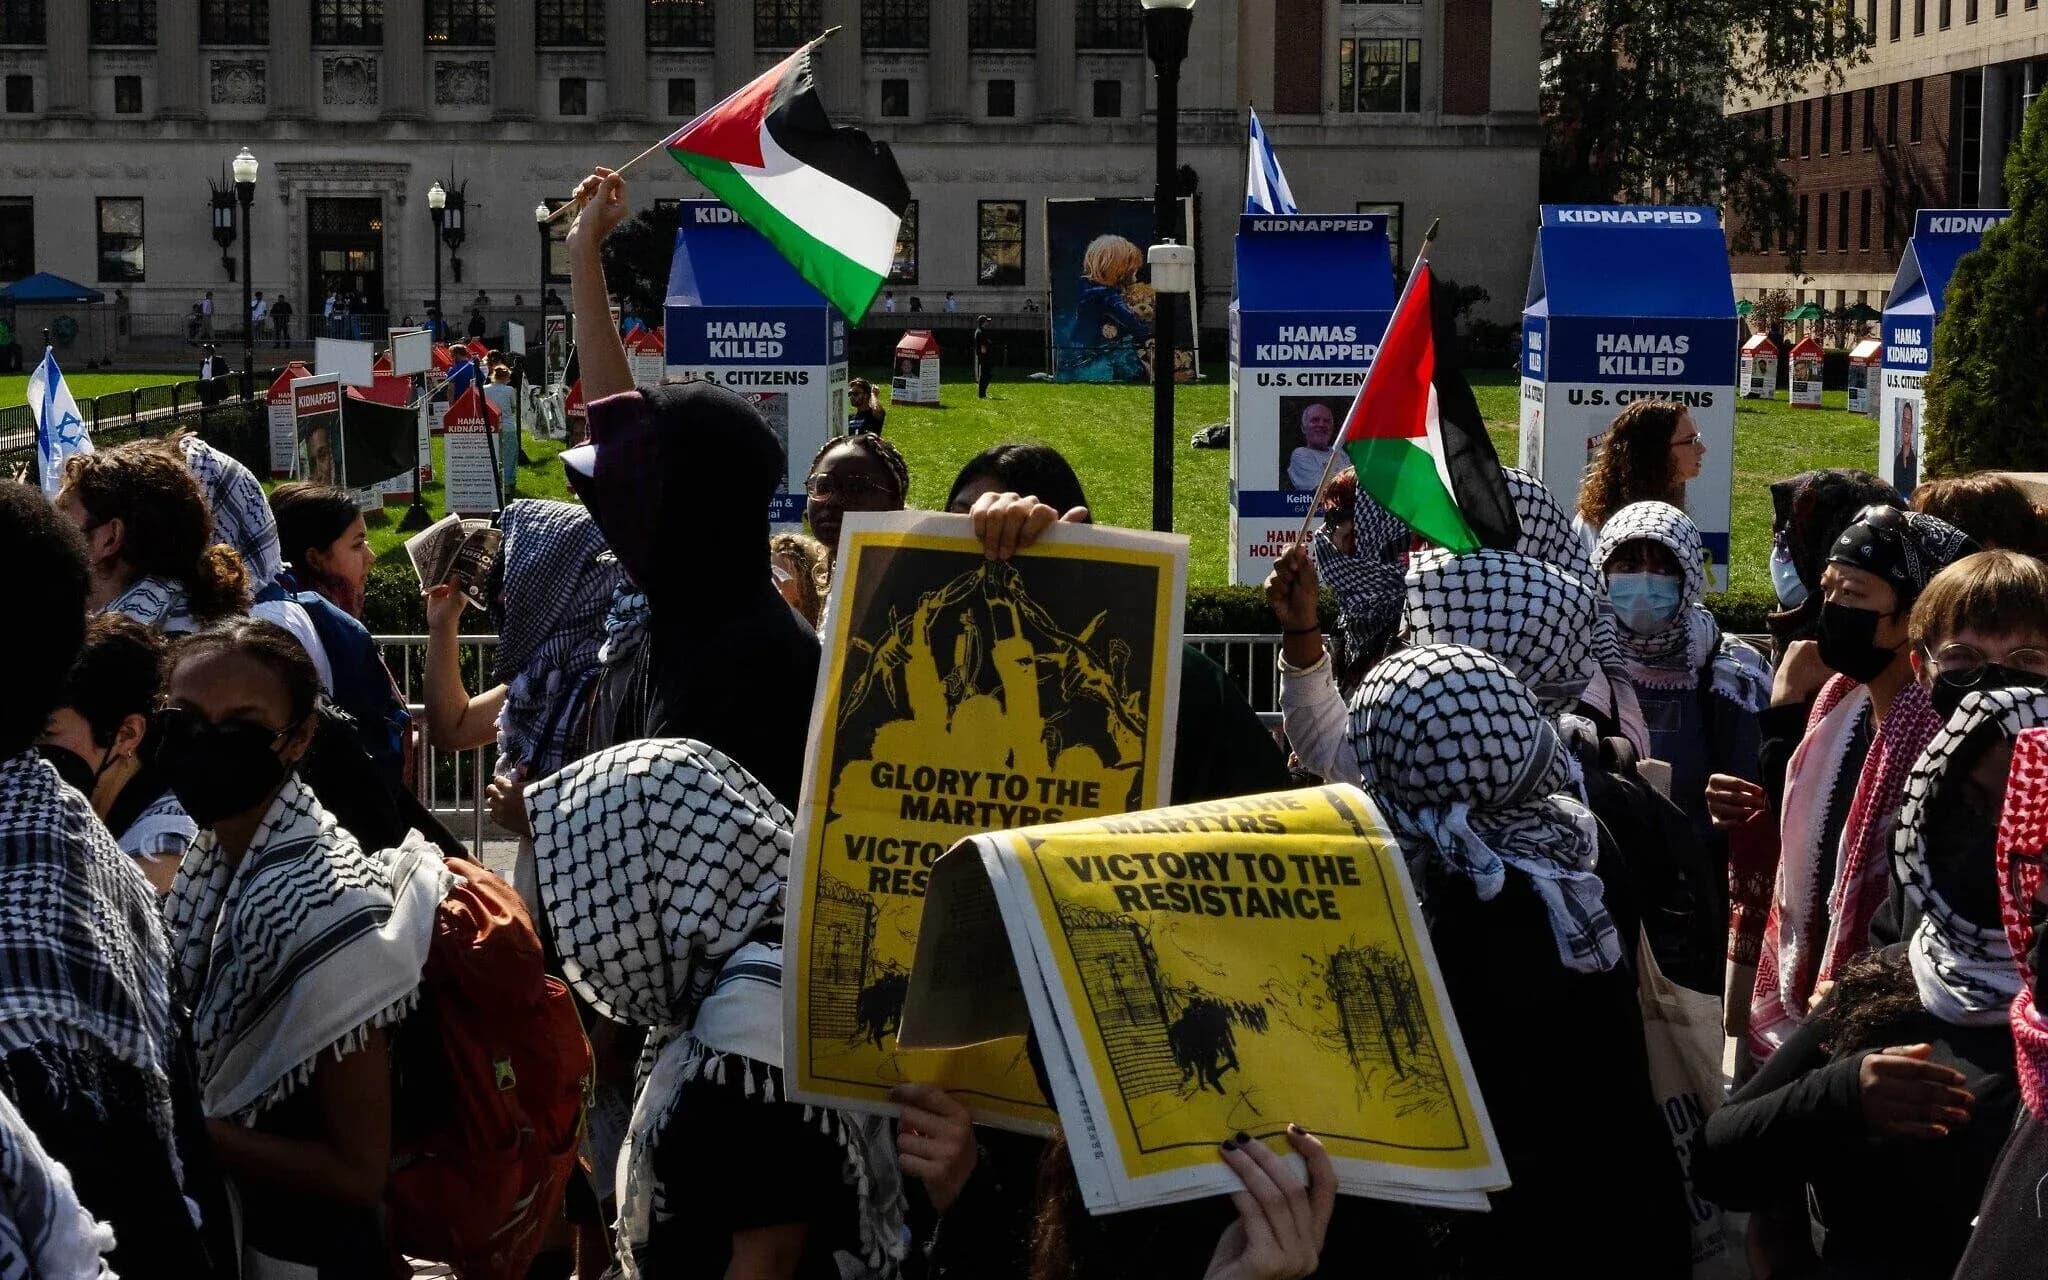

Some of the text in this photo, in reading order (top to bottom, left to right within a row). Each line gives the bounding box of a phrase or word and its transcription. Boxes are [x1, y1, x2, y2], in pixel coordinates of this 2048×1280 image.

[1558, 210, 1702, 224] KIDNAPPED
[1930, 217, 2002, 233] KIDNA
[1253, 220, 1373, 232] KIDNAPPED
[706, 322, 787, 339] HAMAS
[1279, 326, 1357, 342] HAMAS
[1895, 328, 1921, 345] HAMAS
[710, 341, 783, 358] KILLED
[1596, 334, 1690, 354] HAMAS
[1256, 345, 1379, 361] KIDNAPPED
[1887, 346, 1928, 364] KIDNAPPED
[1599, 355, 1685, 376] KILLED
[725, 371, 809, 385] CITIZENS
[1257, 373, 1367, 387] U.S. CITIZEN
[1887, 374, 1900, 388] U.S.
[298, 391, 337, 408] KIDNAPPED
[1568, 389, 1609, 405] U.S.
[784, 498, 794, 508] &
[1286, 494, 1313, 504] Keith
[1266, 530, 1313, 543] HAMS
[870, 761, 1100, 809] GLORY TO THE
[900, 794, 1064, 829] MARTYRS
[1102, 813, 1288, 835] MARTYRS
[844, 834, 946, 869] VICTO
[1063, 851, 1361, 887] VICTORY TO THE
[1113, 884, 1342, 920] RESISTANCE
